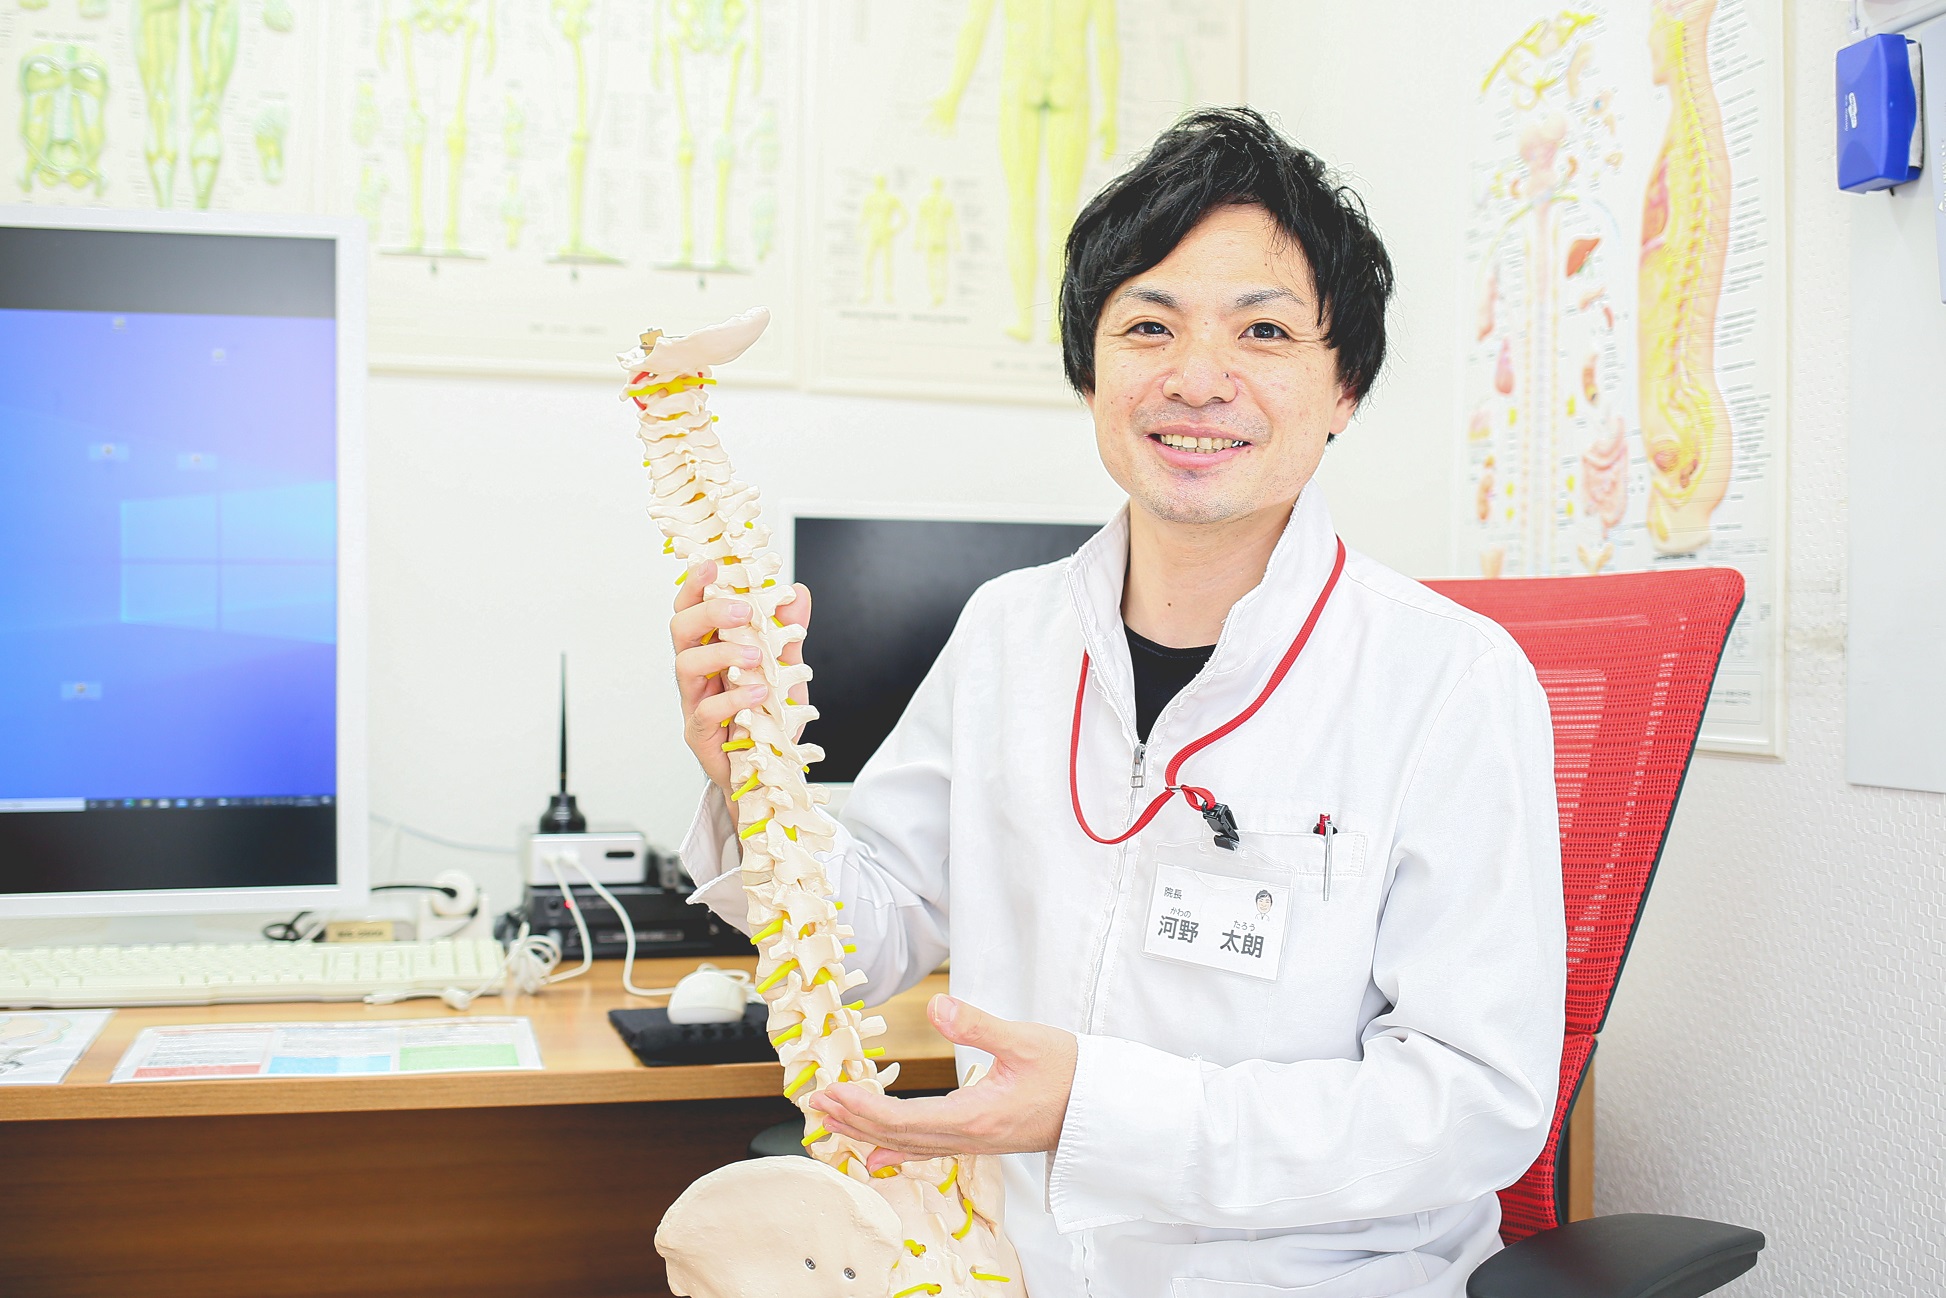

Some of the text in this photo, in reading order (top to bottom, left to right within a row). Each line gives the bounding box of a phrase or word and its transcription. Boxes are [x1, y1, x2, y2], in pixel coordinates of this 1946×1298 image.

[1164, 887, 1182, 900] 院長
[1170, 907, 1256, 931] かわの たろう
[1158, 915, 1264, 958] 河野 太朗
